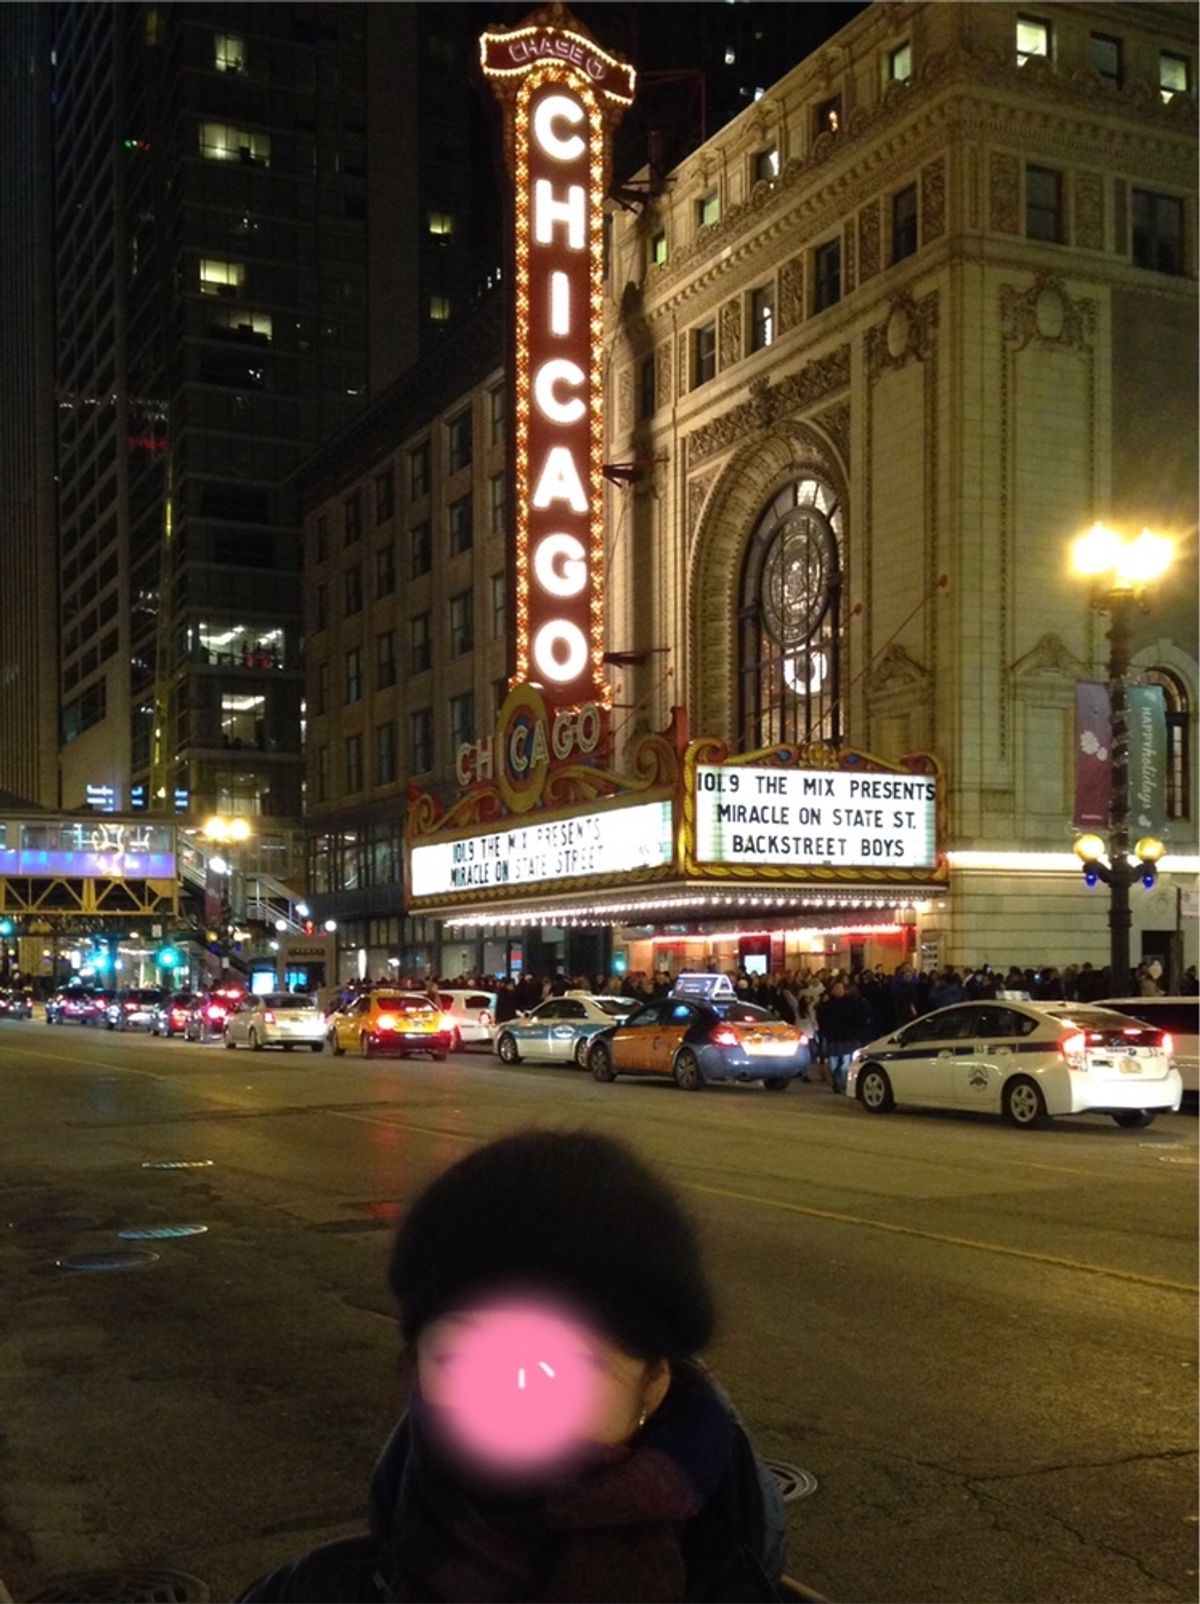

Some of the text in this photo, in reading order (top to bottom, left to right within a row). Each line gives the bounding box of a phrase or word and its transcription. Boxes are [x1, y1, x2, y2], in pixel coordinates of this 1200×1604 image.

[508, 37, 583, 65] CHASE
[533, 94, 589, 682] CHICAGO
[456, 702, 600, 785] CHICAGO
[755, 775, 787, 795] THE
[803, 778, 834, 797] MIX
[850, 780, 936, 801] PRESENTS
[717, 804, 916, 830] MIRACLE ON STATE ST.
[480, 835, 501, 859] THE
[507, 831, 528, 854] MX
[733, 835, 904, 858] BACKSTREET BOYS
[450, 861, 490, 887] MIRACLE
[494, 859, 510, 883] ON
[555, 844, 604, 874] STREET
